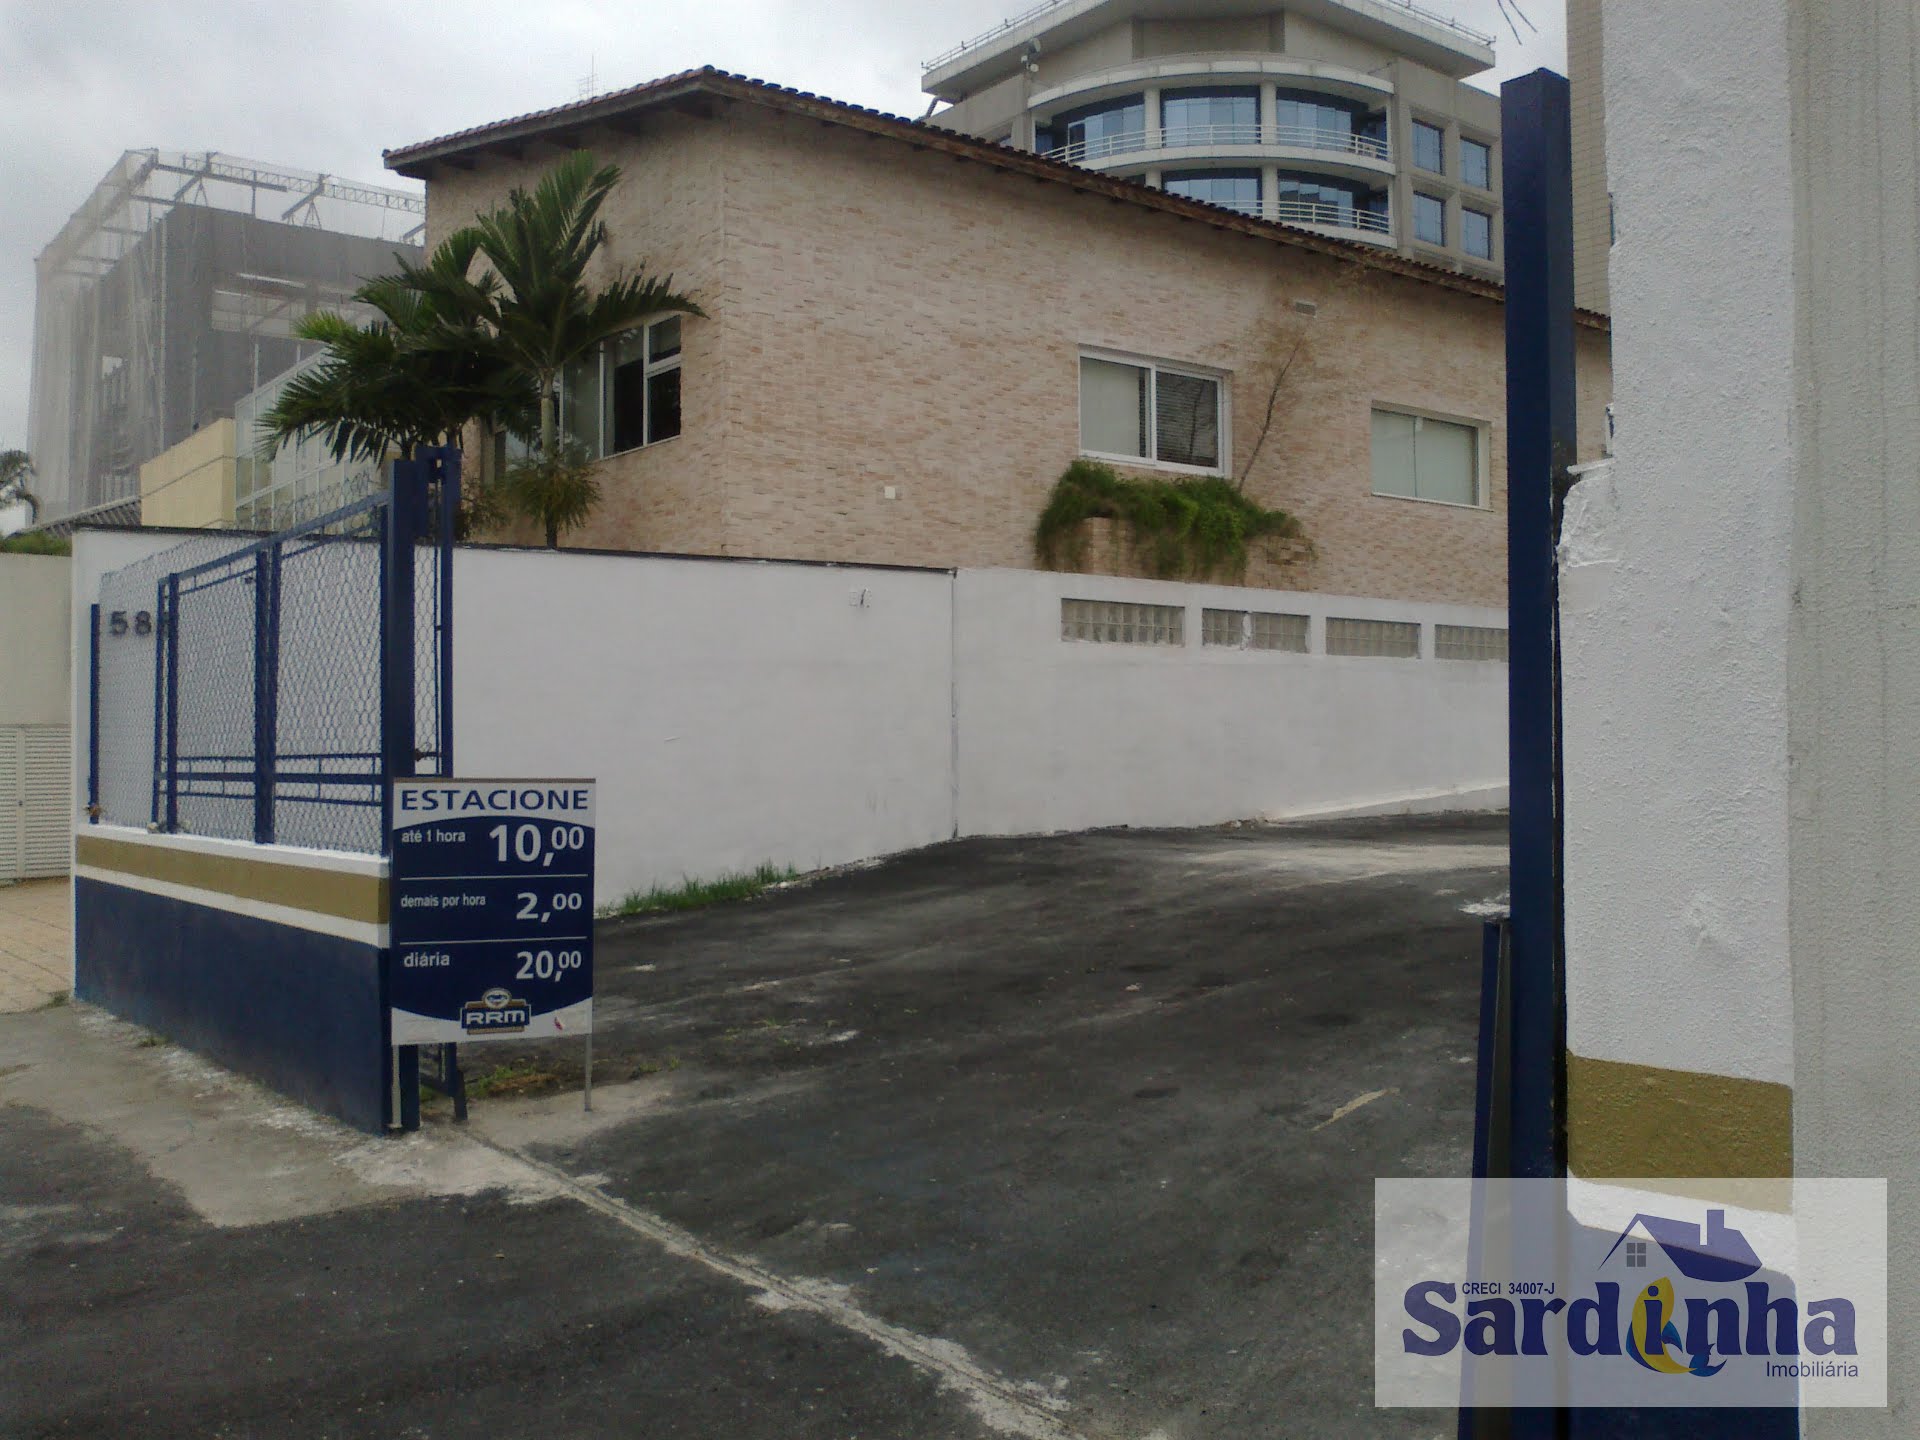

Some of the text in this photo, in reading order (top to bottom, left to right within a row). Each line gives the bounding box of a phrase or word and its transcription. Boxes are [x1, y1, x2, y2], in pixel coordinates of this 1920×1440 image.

[401, 789, 588, 811] ESTACIONE
[401, 830, 422, 843] até
[427, 829, 432, 842] 1
[437, 829, 466, 842] hora
[401, 895, 439, 907] demais
[442, 896, 460, 908] por
[463, 893, 486, 906] hora
[404, 952, 450, 967] diária
